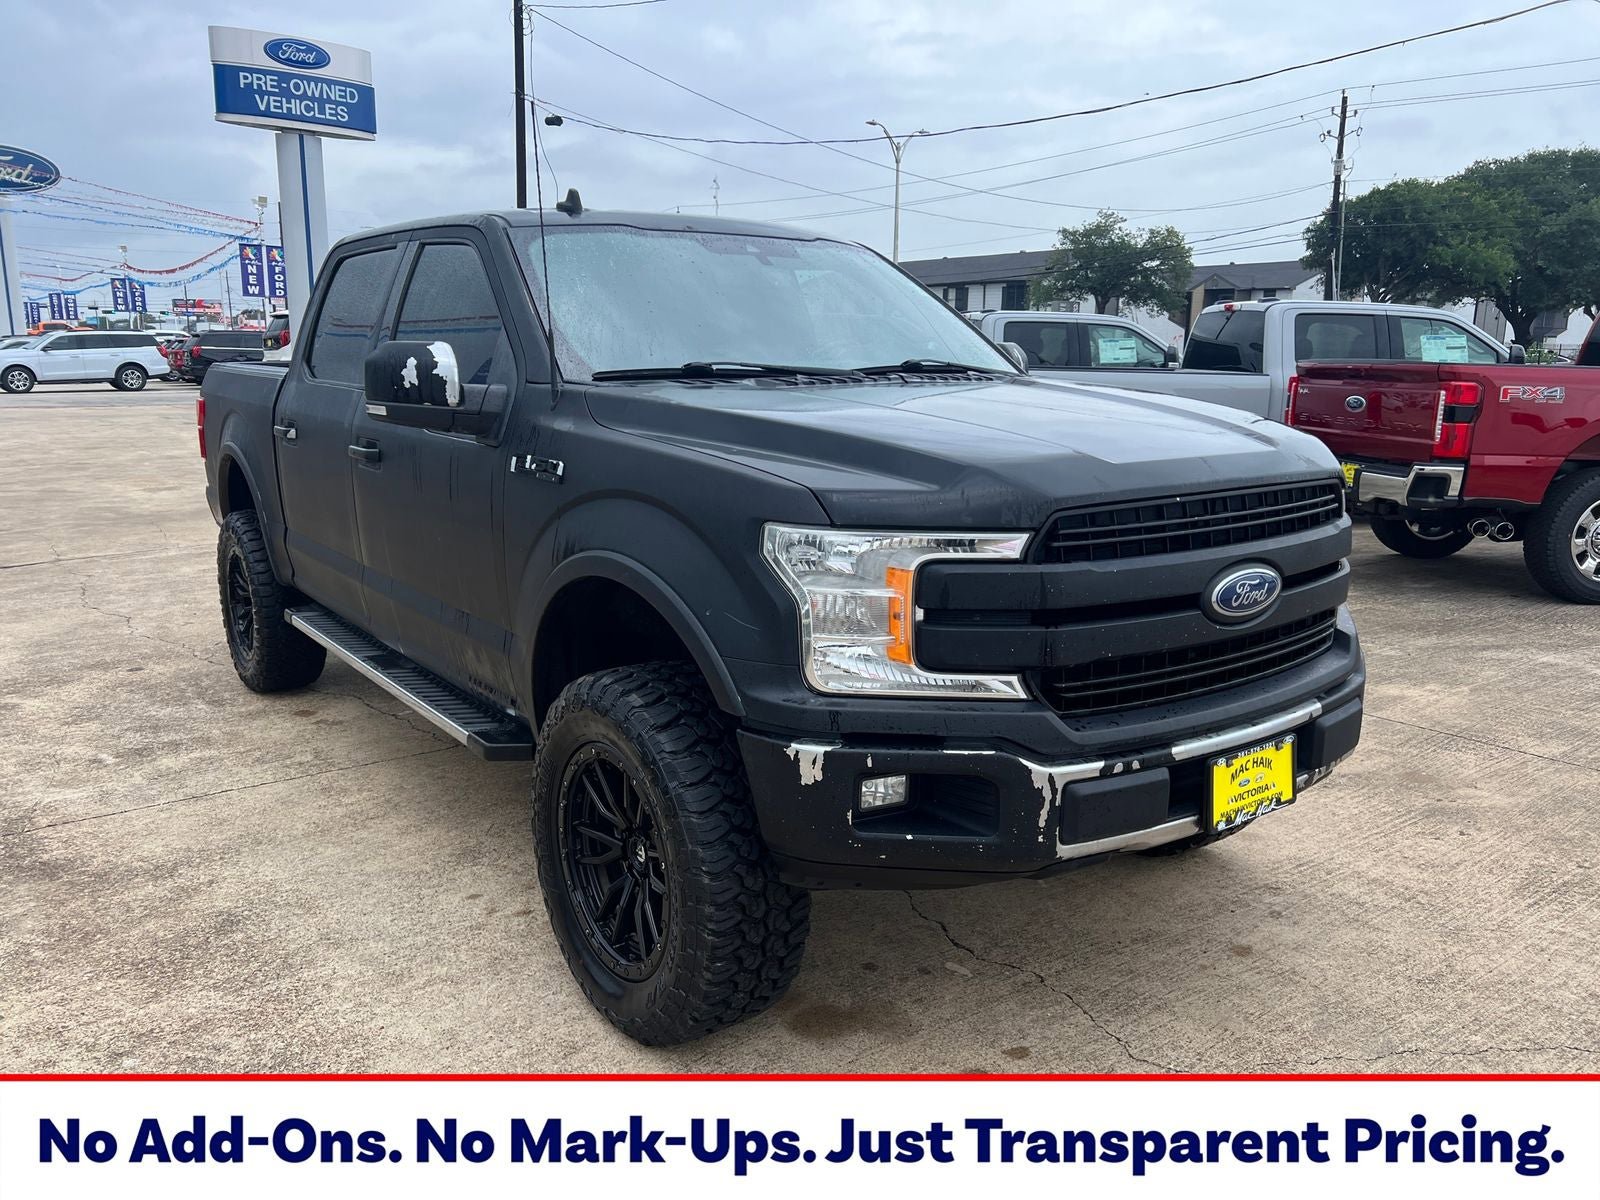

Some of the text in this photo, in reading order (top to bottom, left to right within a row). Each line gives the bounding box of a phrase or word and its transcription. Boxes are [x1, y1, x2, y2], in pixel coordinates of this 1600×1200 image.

[278, 42, 317, 64] Ford
[238, 71, 359, 104] PRE-OWNED
[254, 94, 349, 122] VEHICLES
[247, 264, 260, 295] NEW
[274, 266, 285, 297] FORD
[115, 291, 126, 311] NEW
[134, 291, 143, 312] FORD
[1499, 385, 1565, 402] FX4
[1231, 579, 1269, 607] Ford
[1230, 759, 1250, 785] MAC
[1252, 756, 1273, 771] HAIK
[1233, 783, 1270, 803] VICTORIA
[1234, 797, 1288, 826] Mac Haik
